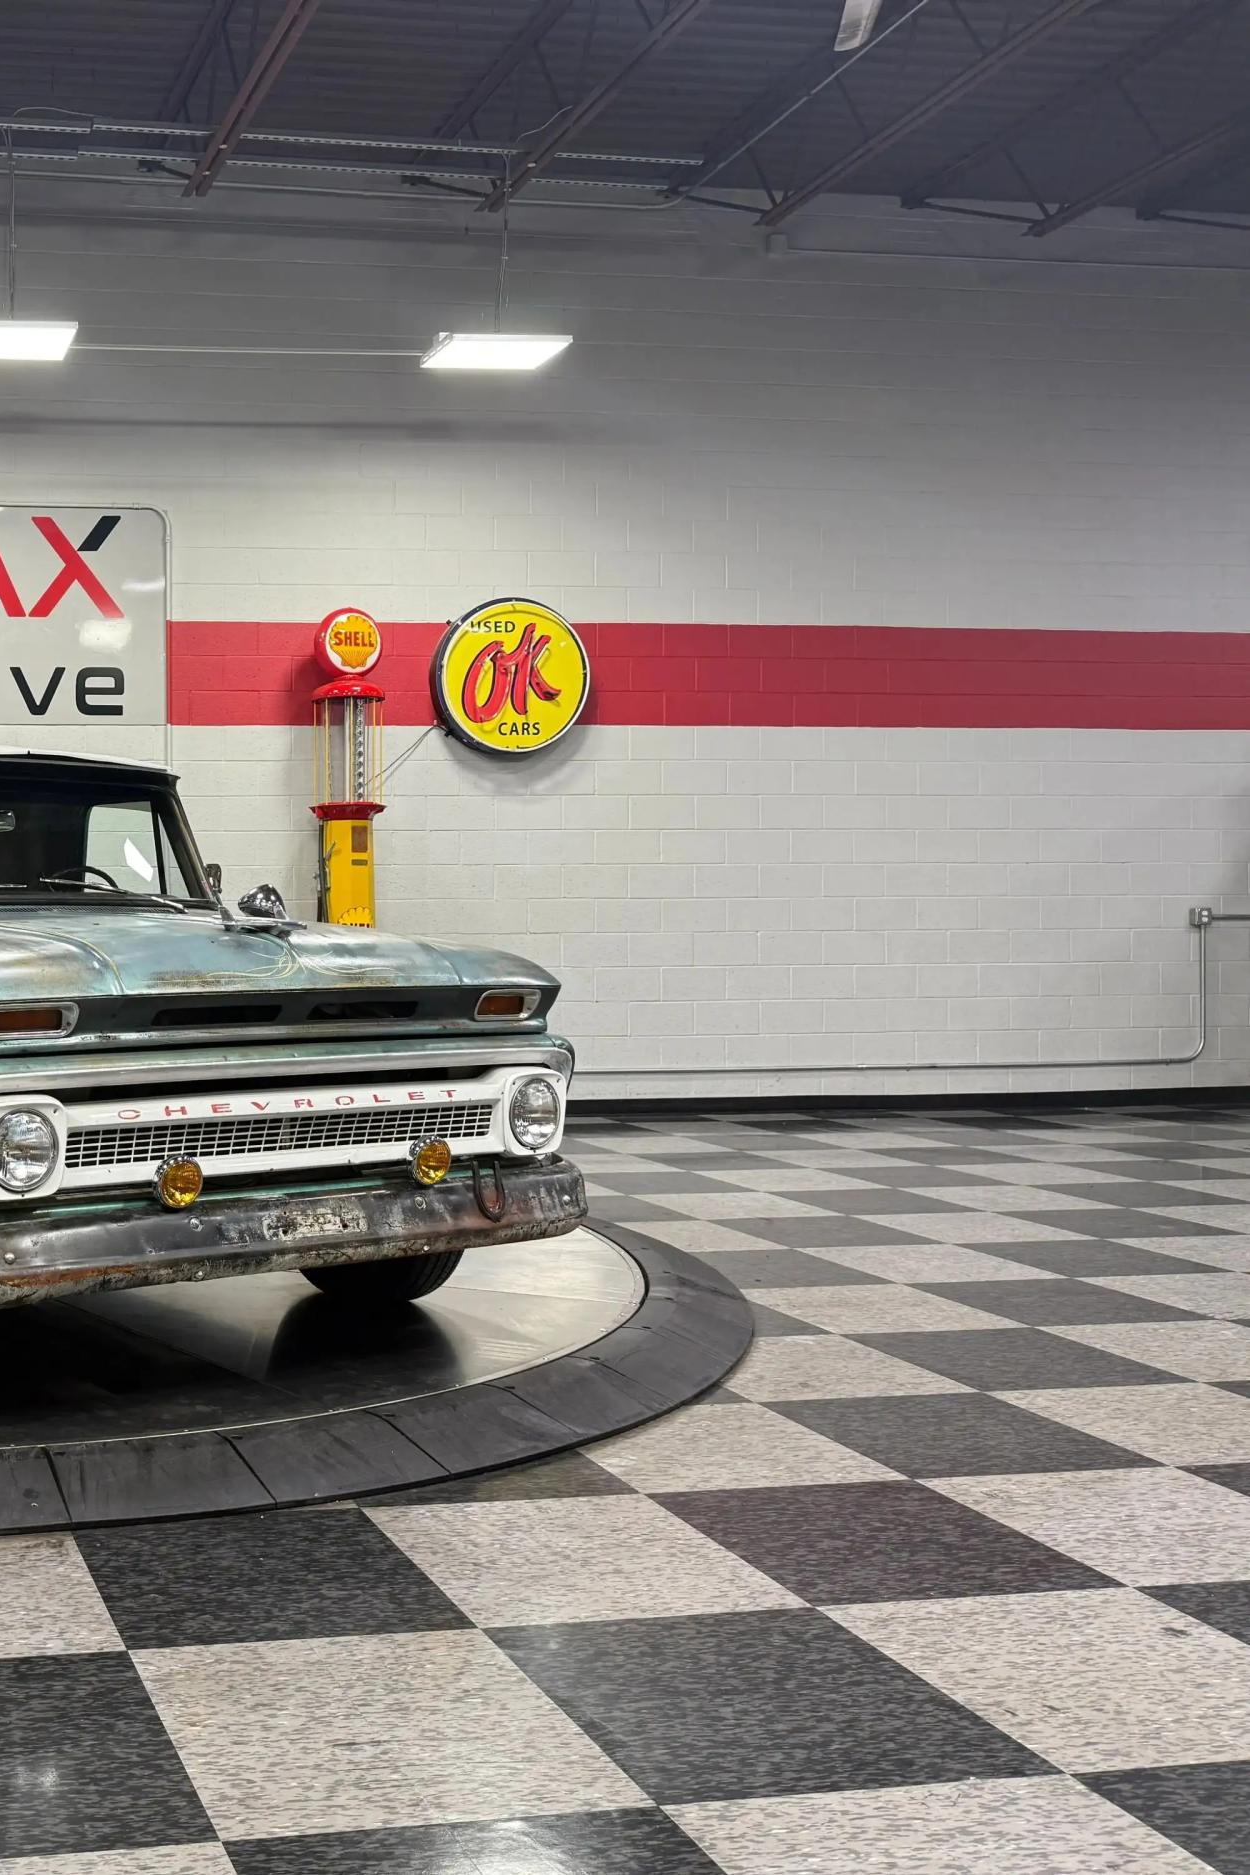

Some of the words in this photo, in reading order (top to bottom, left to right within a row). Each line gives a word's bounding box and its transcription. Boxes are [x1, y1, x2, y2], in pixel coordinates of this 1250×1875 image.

[470, 620, 516, 634] USED
[333, 630, 375, 649] SHELL
[461, 622, 561, 723] OK
[498, 722, 541, 736] CARS
[117, 1088, 457, 1120] CHEVROLET
